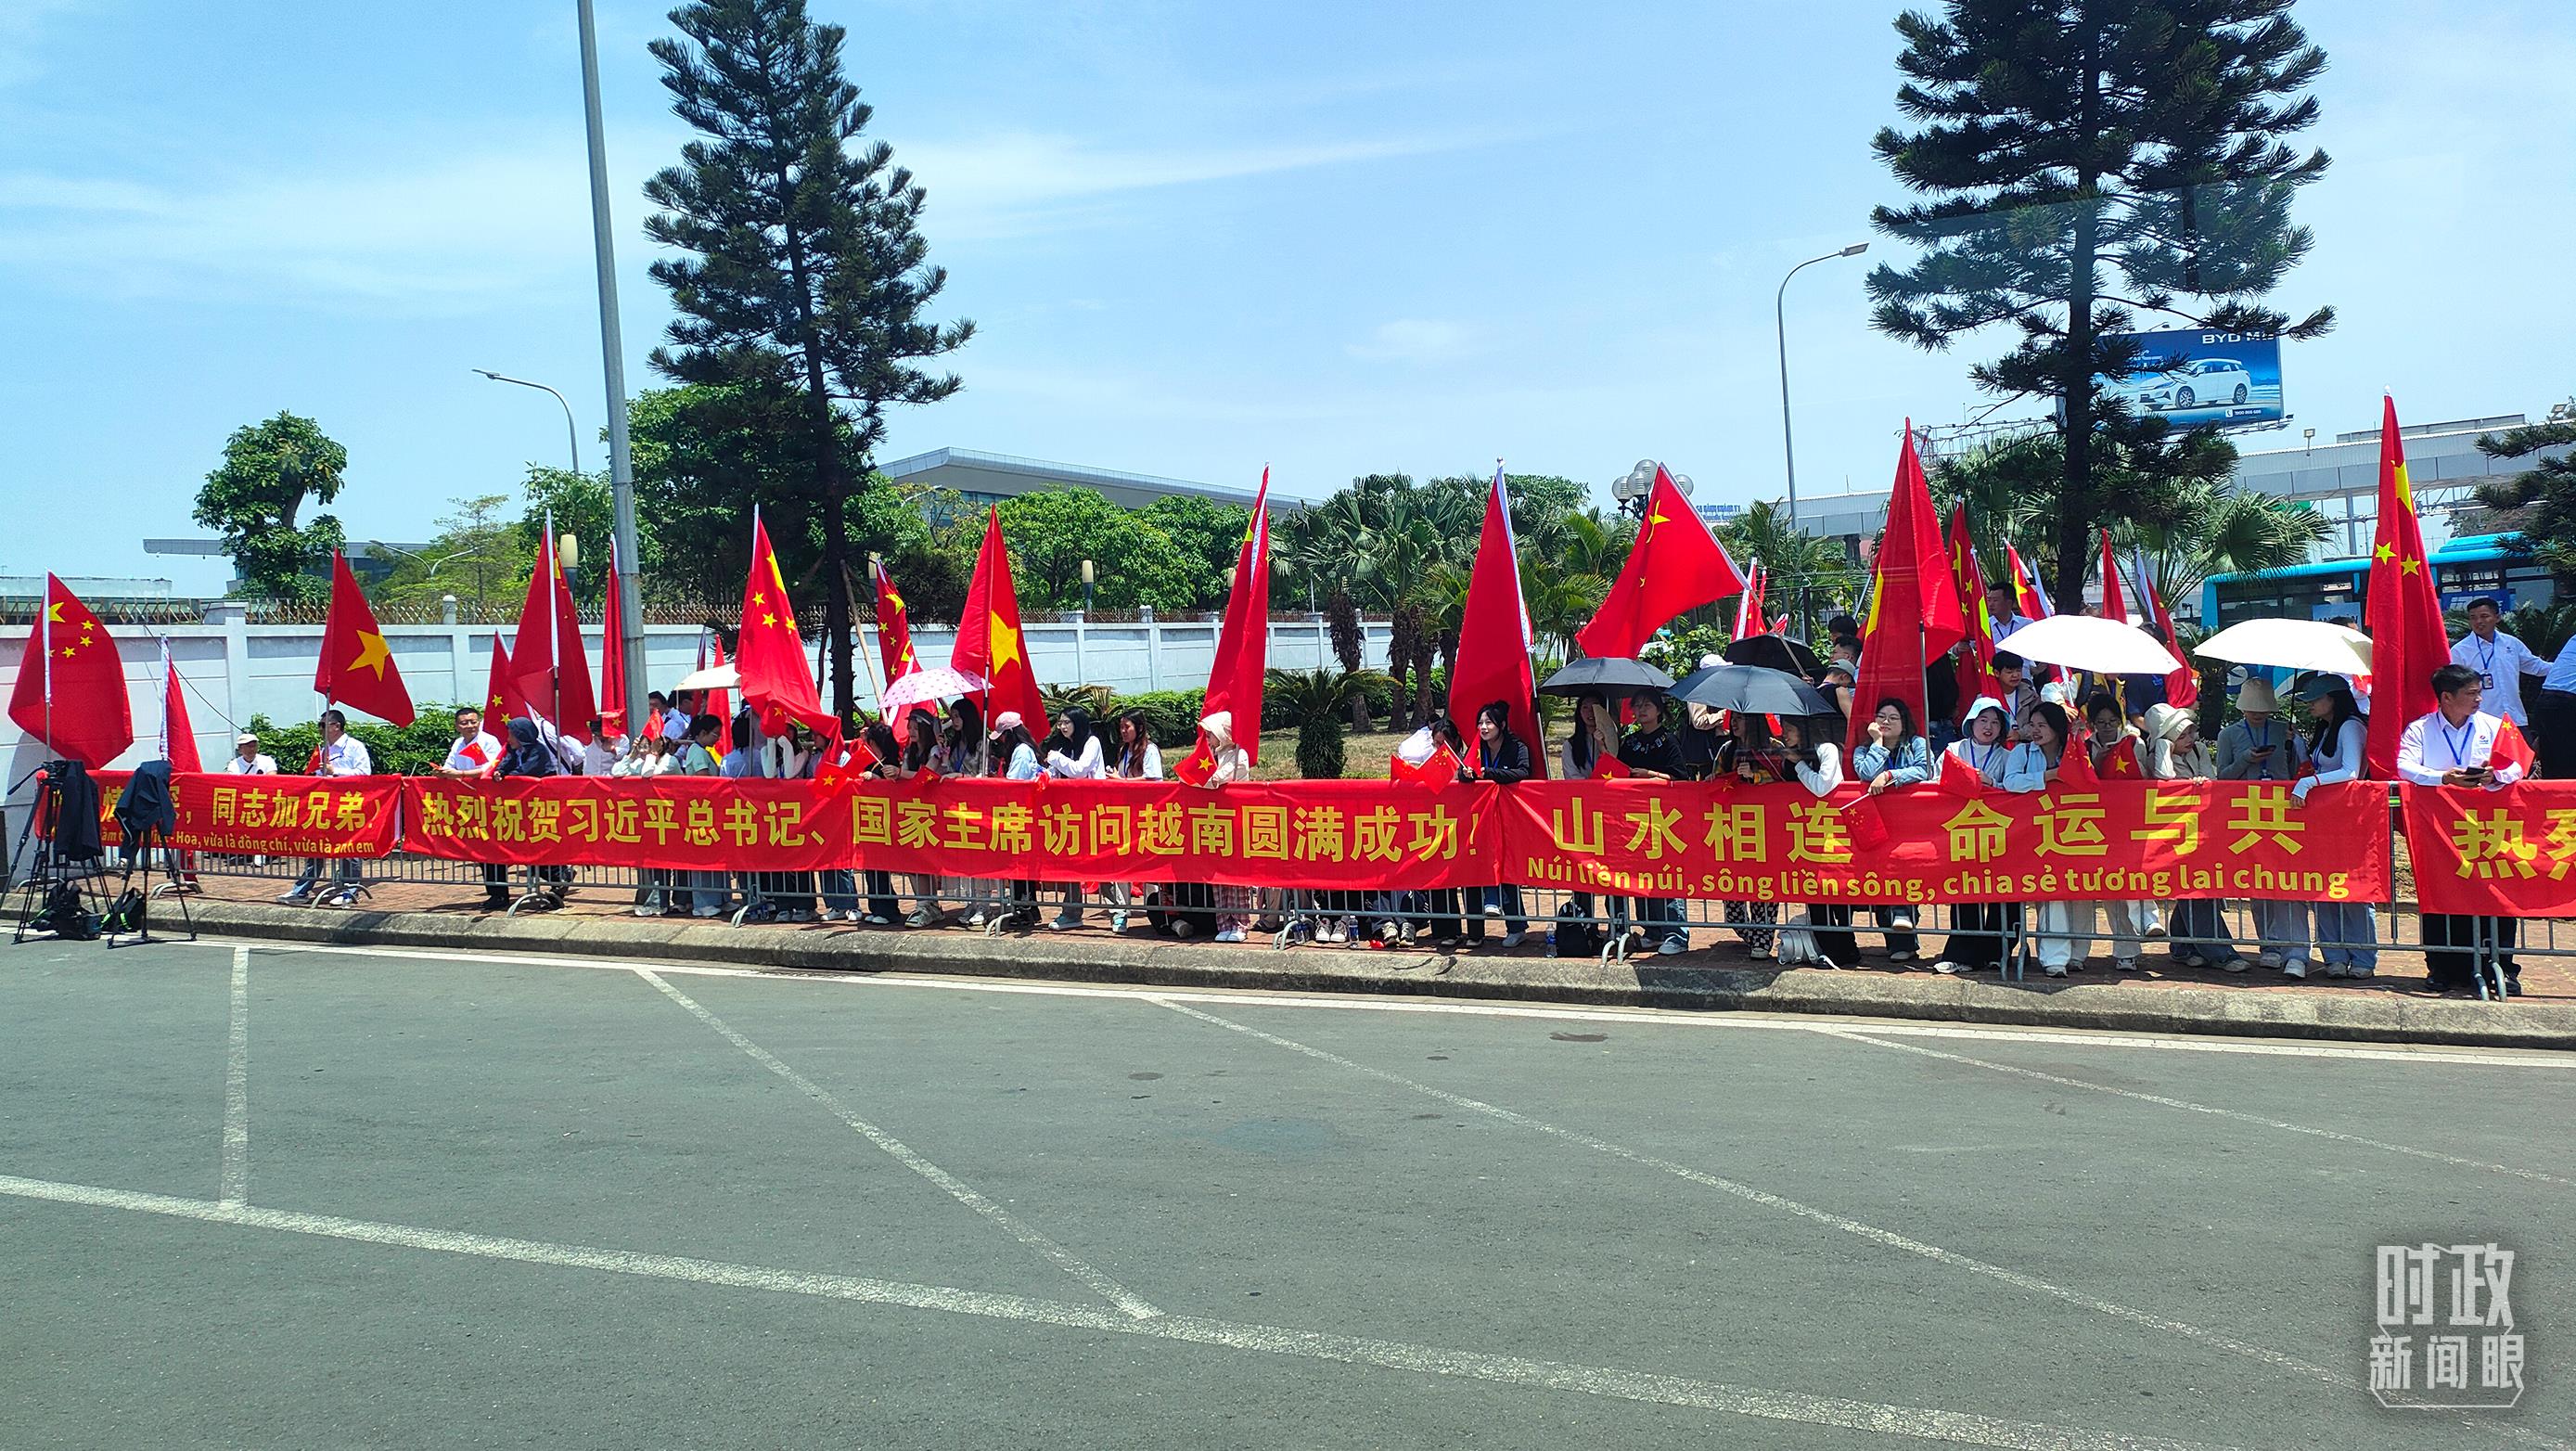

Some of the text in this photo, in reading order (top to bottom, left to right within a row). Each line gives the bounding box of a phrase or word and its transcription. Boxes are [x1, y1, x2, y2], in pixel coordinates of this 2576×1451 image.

[2202, 333, 2241, 344] BYD
[203, 831, 224, 848] vừa
[225, 833, 236, 848] là
[237, 834, 268, 853] đồng
[269, 836, 292, 854] chí,
[294, 836, 317, 853] vừa
[319, 837, 332, 854] là
[333, 839, 354, 854] anh
[356, 841, 376, 853] em
[1553, 786, 2305, 864] 山水相连 命运与共
[1528, 854, 2350, 902] Núi liền núi, sông liền sông, chia sẻ tương lai chung
